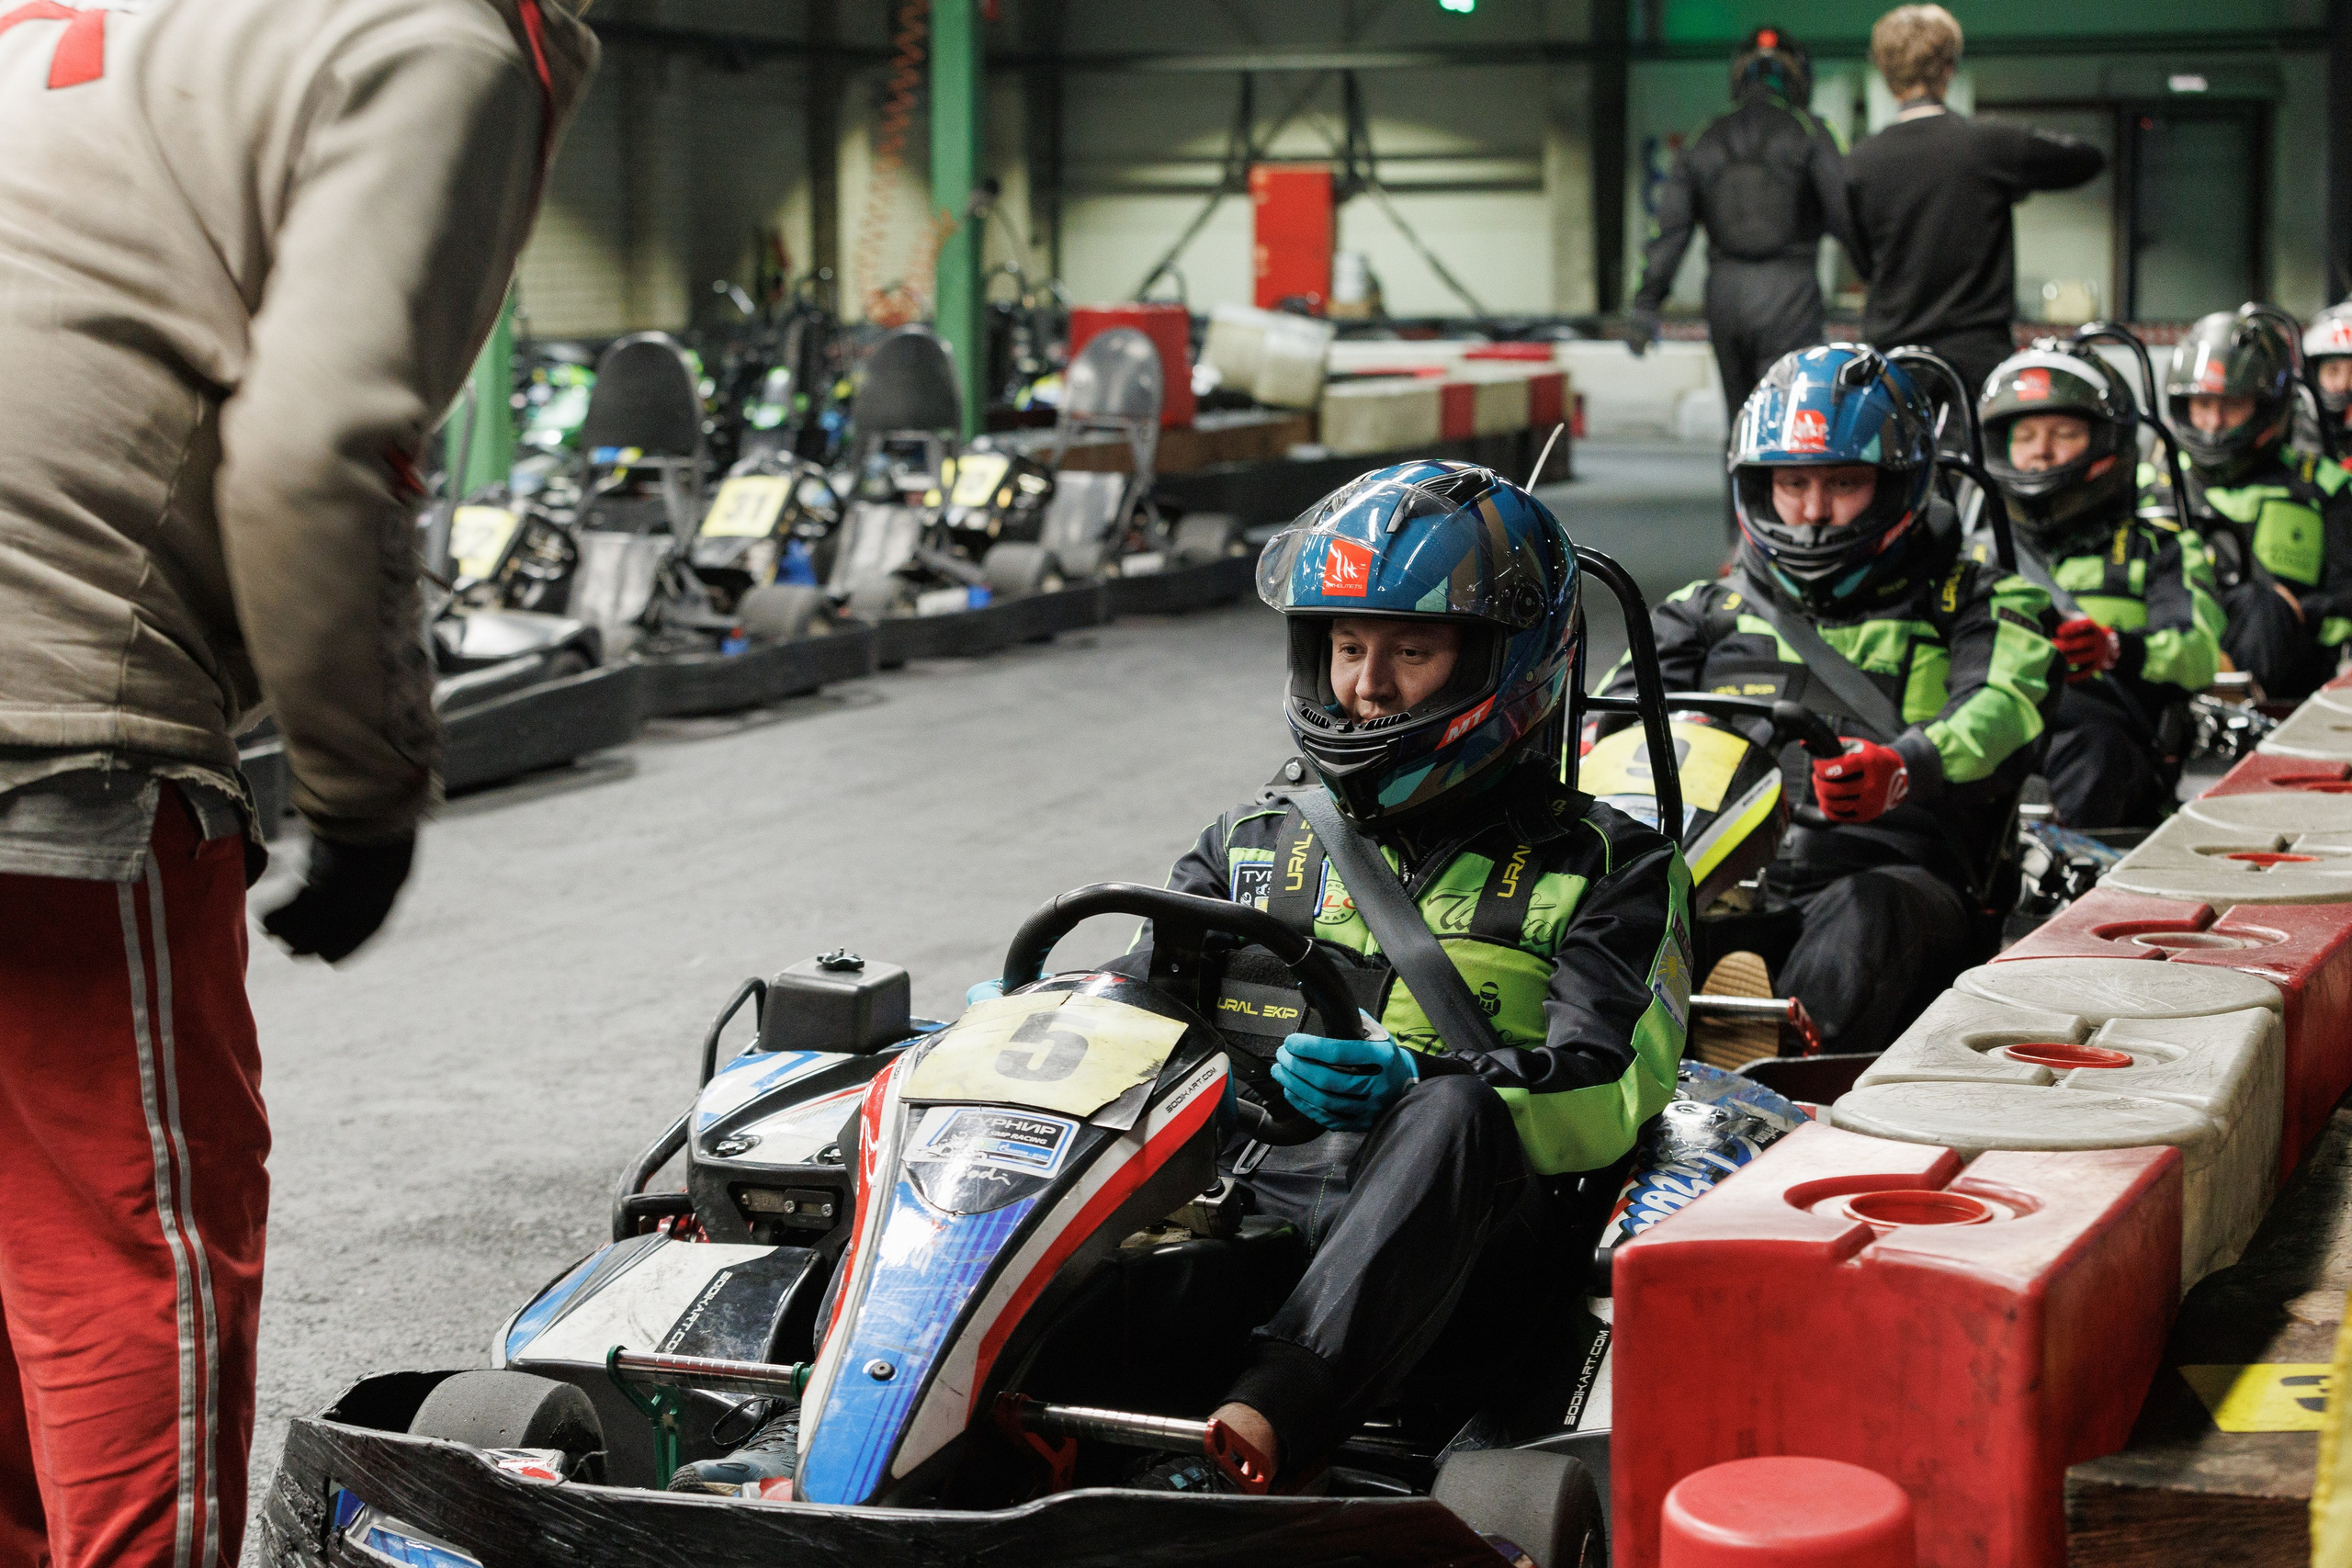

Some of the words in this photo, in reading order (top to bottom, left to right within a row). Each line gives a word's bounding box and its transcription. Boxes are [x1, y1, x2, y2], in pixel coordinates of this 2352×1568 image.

[1445, 703, 1489, 743] MT
[1284, 833, 1314, 891] URAL
[1216, 997, 1259, 1016] URAL
[1261, 1004, 1299, 1020] EKIP
[994, 1011, 1100, 1082] 5
[964, 1115, 1057, 1135] ТУРНИР
[989, 1130, 1012, 1138] SMP
[1011, 1133, 1049, 1146] RACING
